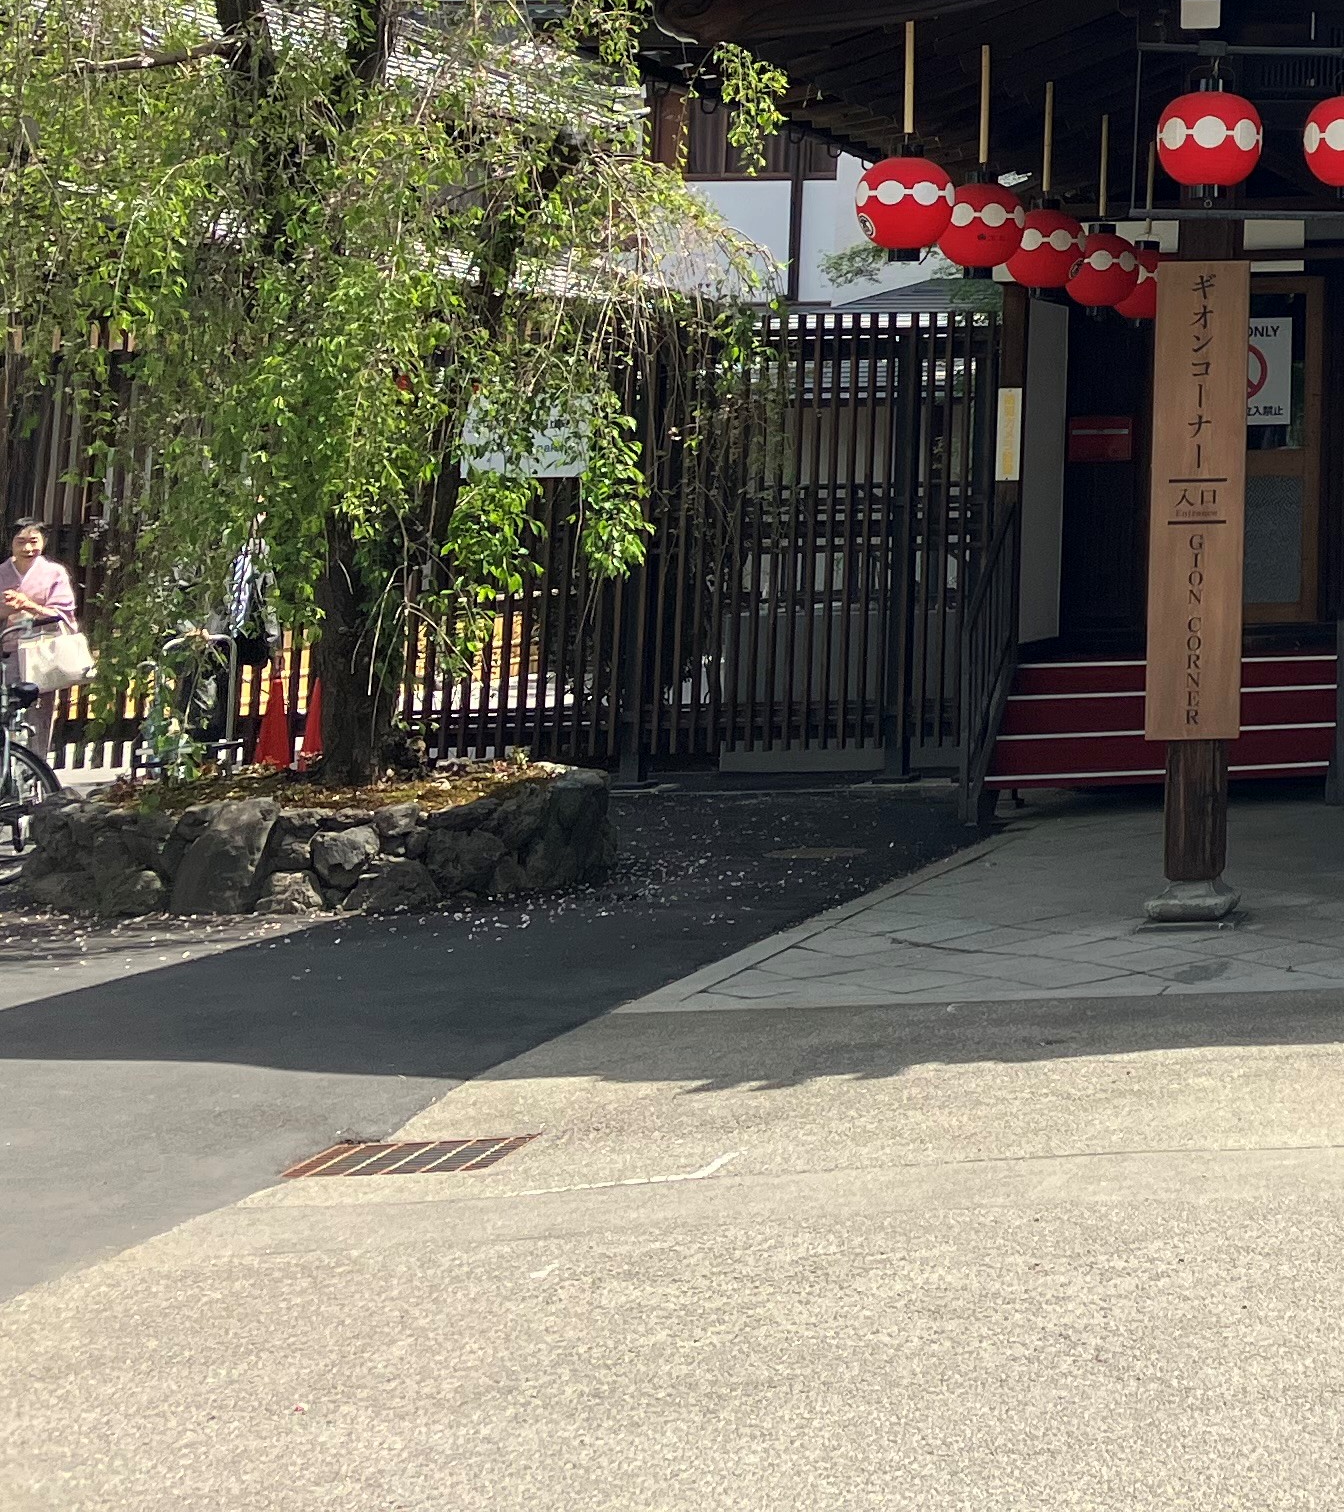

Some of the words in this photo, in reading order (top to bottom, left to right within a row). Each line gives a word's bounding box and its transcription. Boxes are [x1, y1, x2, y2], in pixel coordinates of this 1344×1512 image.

[1187, 273, 1217, 469] ギオンコーナー
[1174, 488, 1217, 507] 入口
[1188, 533, 1205, 606] GION
[1186, 616, 1202, 726] CORNER
